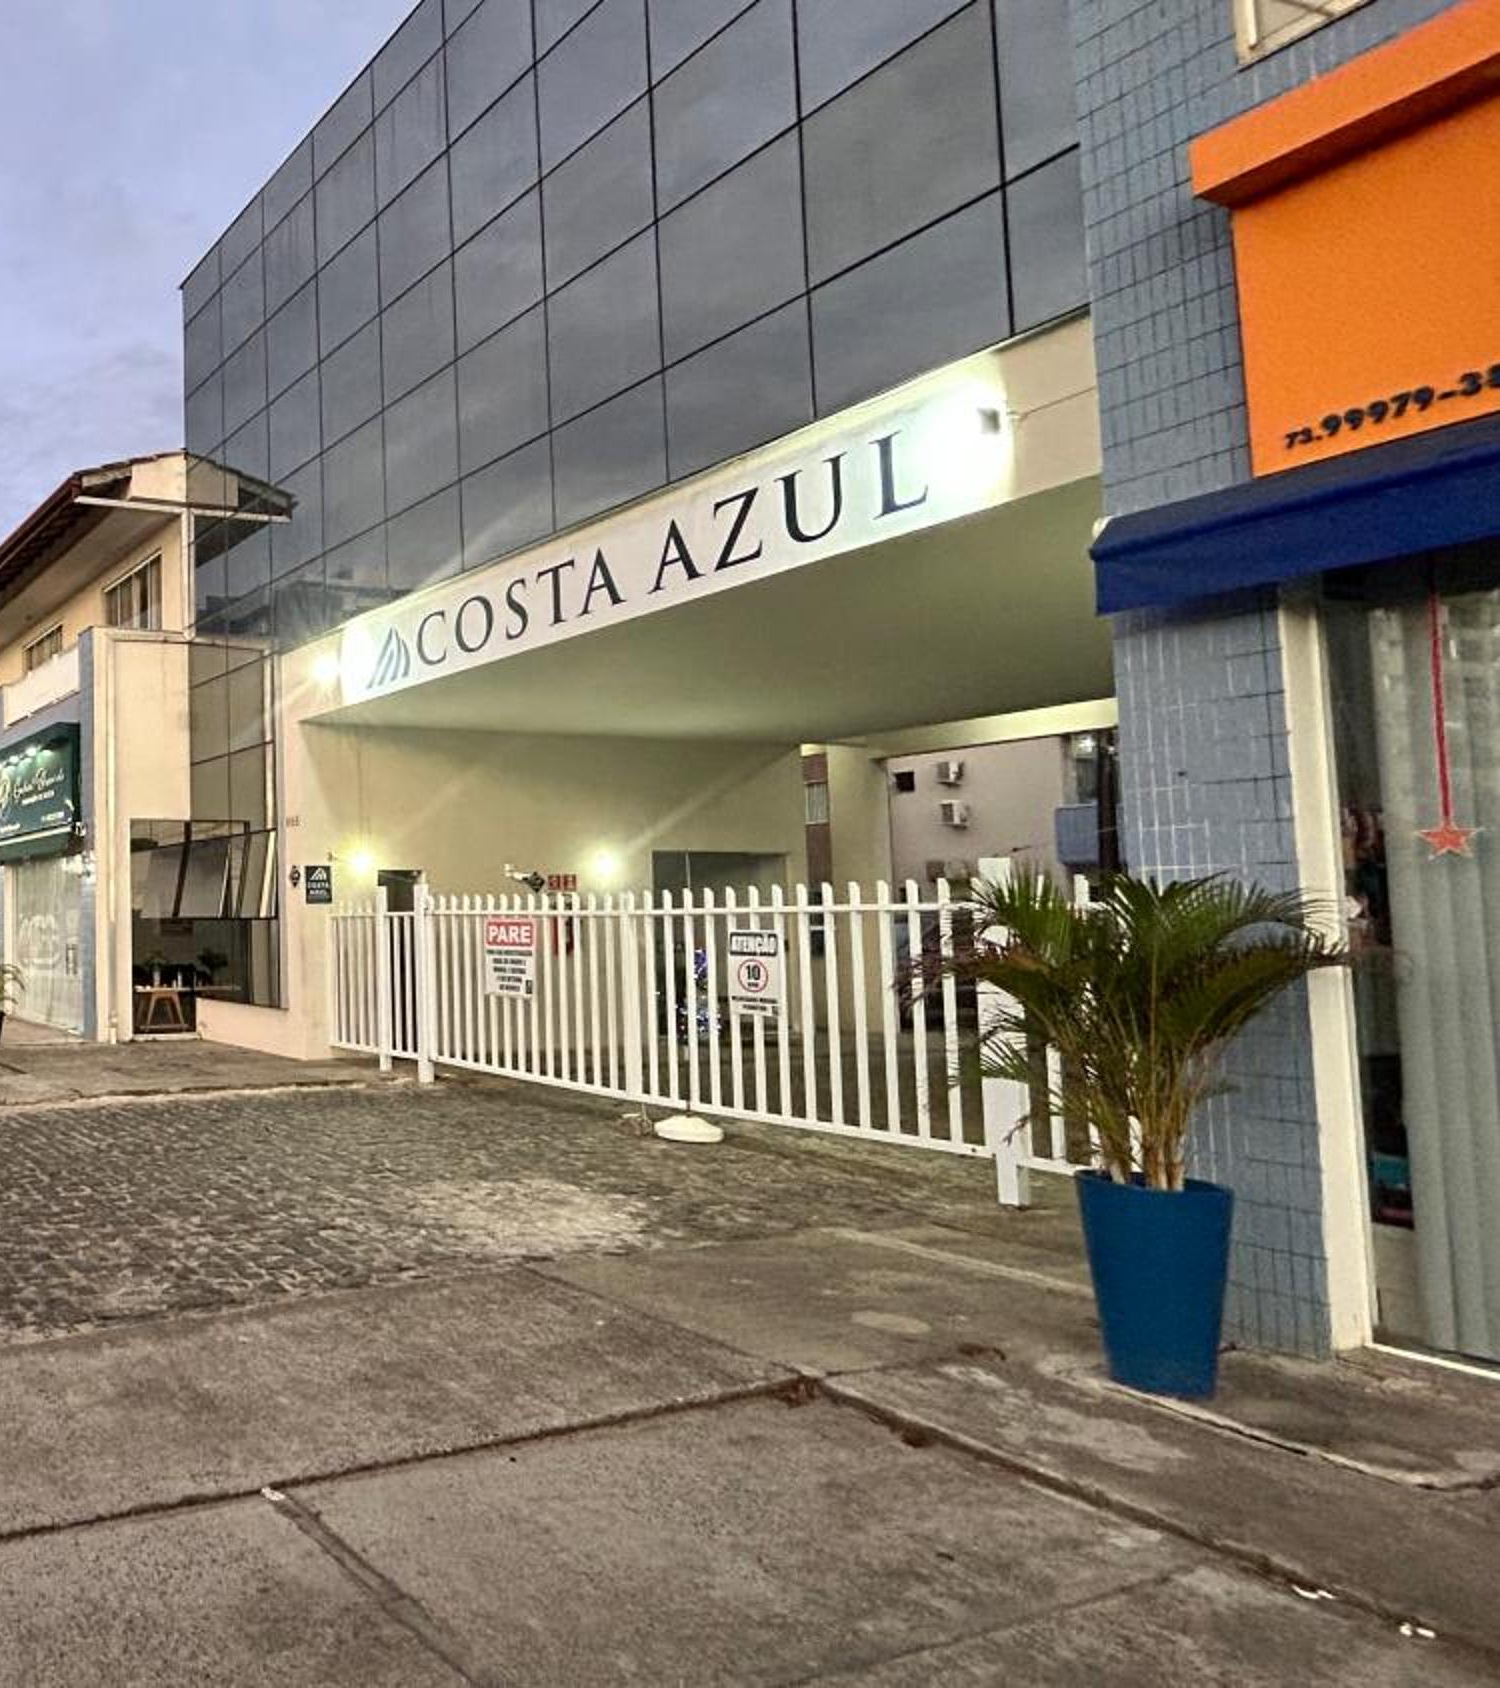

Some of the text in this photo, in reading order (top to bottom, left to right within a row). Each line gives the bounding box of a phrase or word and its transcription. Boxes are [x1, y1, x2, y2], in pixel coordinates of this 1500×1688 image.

[415, 429, 929, 666] COSTA AZUL
[488, 925, 531, 944] PARE
[731, 932, 776, 956] ATENÇÃO
[745, 964, 761, 981] 10
